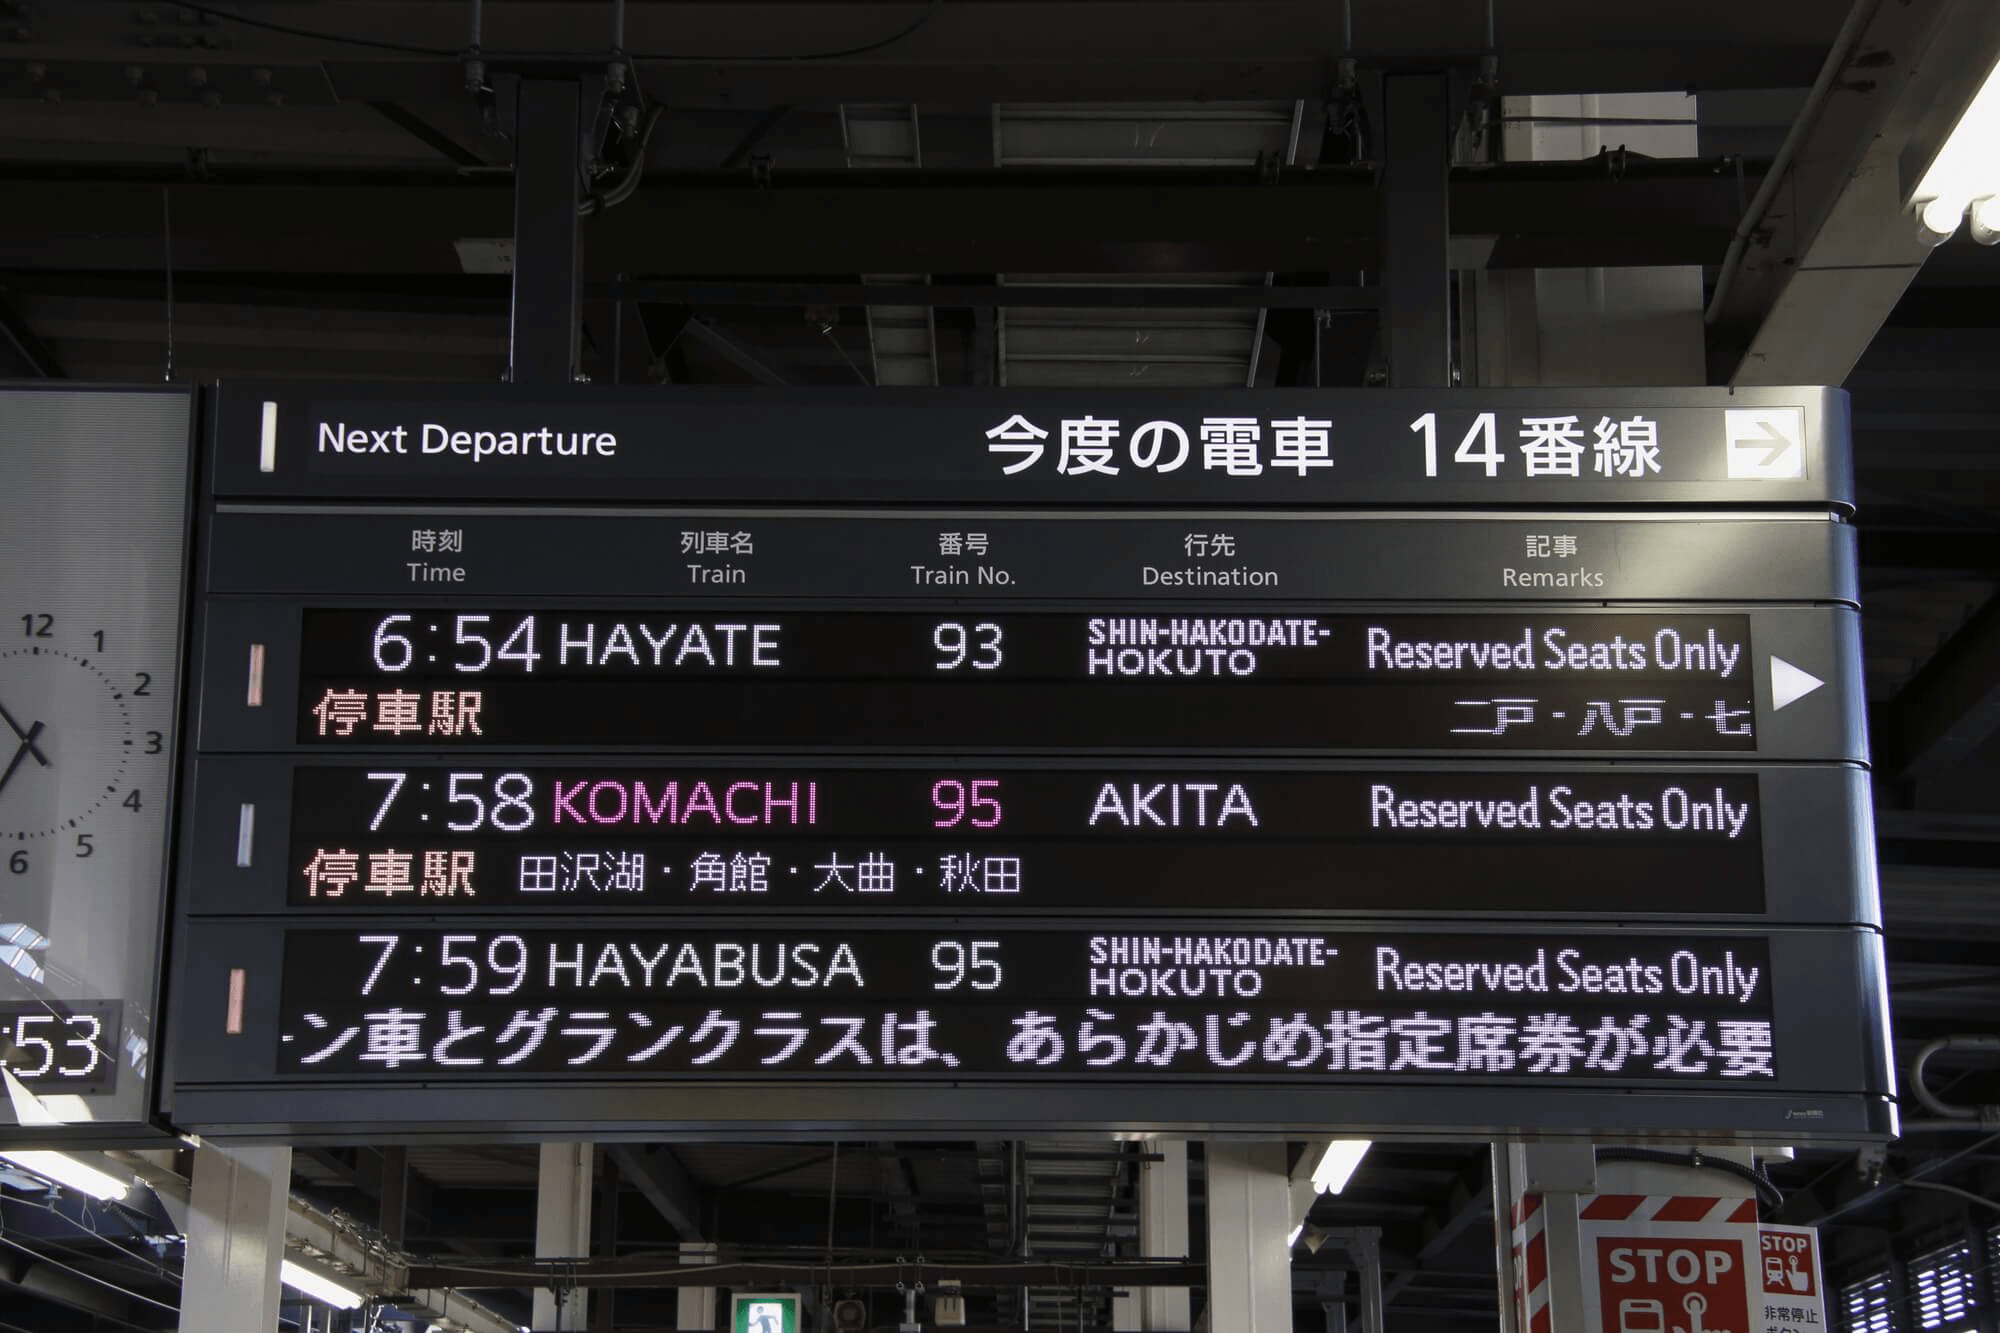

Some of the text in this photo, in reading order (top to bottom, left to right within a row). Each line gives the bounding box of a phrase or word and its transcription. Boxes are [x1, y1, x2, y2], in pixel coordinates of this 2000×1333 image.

[318, 422, 617, 463] Next Departure
[984, 412, 1661, 478] 今度の電車 14番線
[411, 528, 463, 553] 時刻
[680, 530, 753, 555] 列車名
[938, 532, 989, 556] 番号
[1184, 533, 1236, 557] 行先
[1525, 534, 1578, 558] 記事
[406, 562, 466, 582] Time
[687, 563, 746, 584] Train
[910, 565, 1016, 585] Train No.
[1143, 566, 1278, 586] Destination
[1502, 567, 1604, 588] Remarks
[21, 613, 54, 637] 12
[1088, 618, 1331, 646] SHIN-HAKODATE-
[93, 630, 105, 653] 1
[373, 614, 781, 673] 6:54 HAYATE
[933, 622, 1003, 670] 93
[1367, 627, 1740, 678] Reserved Seats Only
[1088, 648, 1256, 676] HOKUTO
[133, 672, 151, 696] 2
[312, 688, 483, 736] 停車駅
[144, 731, 163, 755] 3
[122, 789, 142, 813] 4
[367, 772, 817, 832] 7:58 KOMACHI
[932, 779, 1002, 828] 95
[1088, 783, 1259, 827] AKITA
[1371, 784, 1748, 838] Reserved Seats Only
[75, 834, 94, 858] 5
[9, 850, 29, 874] 6
[302, 848, 476, 897] 停車駅
[931, 940, 1002, 990] 95
[1090, 936, 1339, 966] SHIN-HAKODATE-
[359, 935, 865, 996] 7:59 HAYABUSA
[1376, 946, 1759, 1003] Reserved Seats Only
[1090, 967, 1262, 997] HOKUTO
[281, 1007, 1774, 1077] ン車とグランクラスは、あらかじめ指定席券が必要
[1761, 1235, 1808, 1253] STOP
[1609, 1247, 1733, 1285] STOP
[1764, 1305, 1819, 1324] 非常停止
